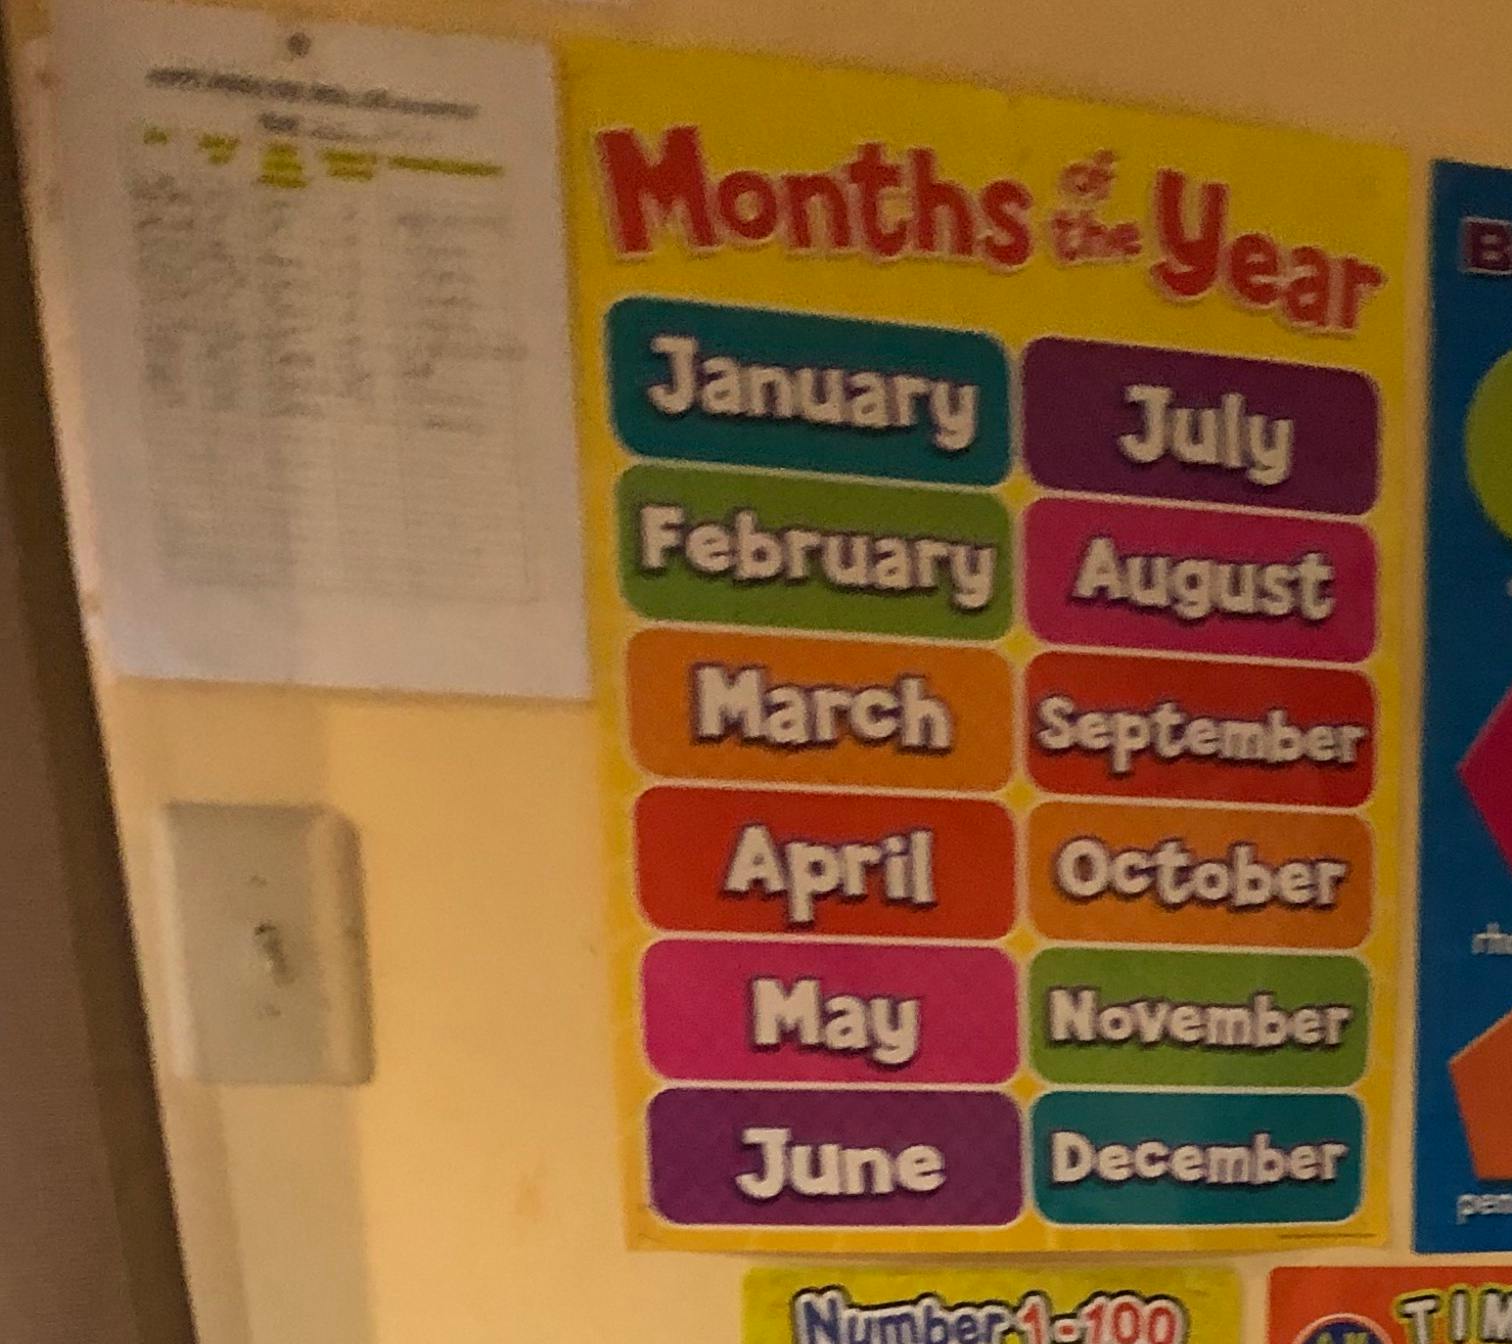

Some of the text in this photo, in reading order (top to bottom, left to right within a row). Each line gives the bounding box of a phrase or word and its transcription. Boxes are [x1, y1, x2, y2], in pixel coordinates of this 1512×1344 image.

[598, 126, 1385, 333] Months of the Year
[649, 334, 980, 451] January
[1120, 385, 1293, 486] July
[640, 503, 995, 609] February
[1075, 538, 1336, 622] August
[694, 665, 951, 751] March
[1038, 696, 1364, 776] September
[724, 825, 937, 922] April
[1057, 838, 1346, 909] October
[751, 978, 919, 1065] May
[1049, 987, 1352, 1047] November
[737, 1127, 946, 1198] June
[1052, 1131, 1346, 1186] December
